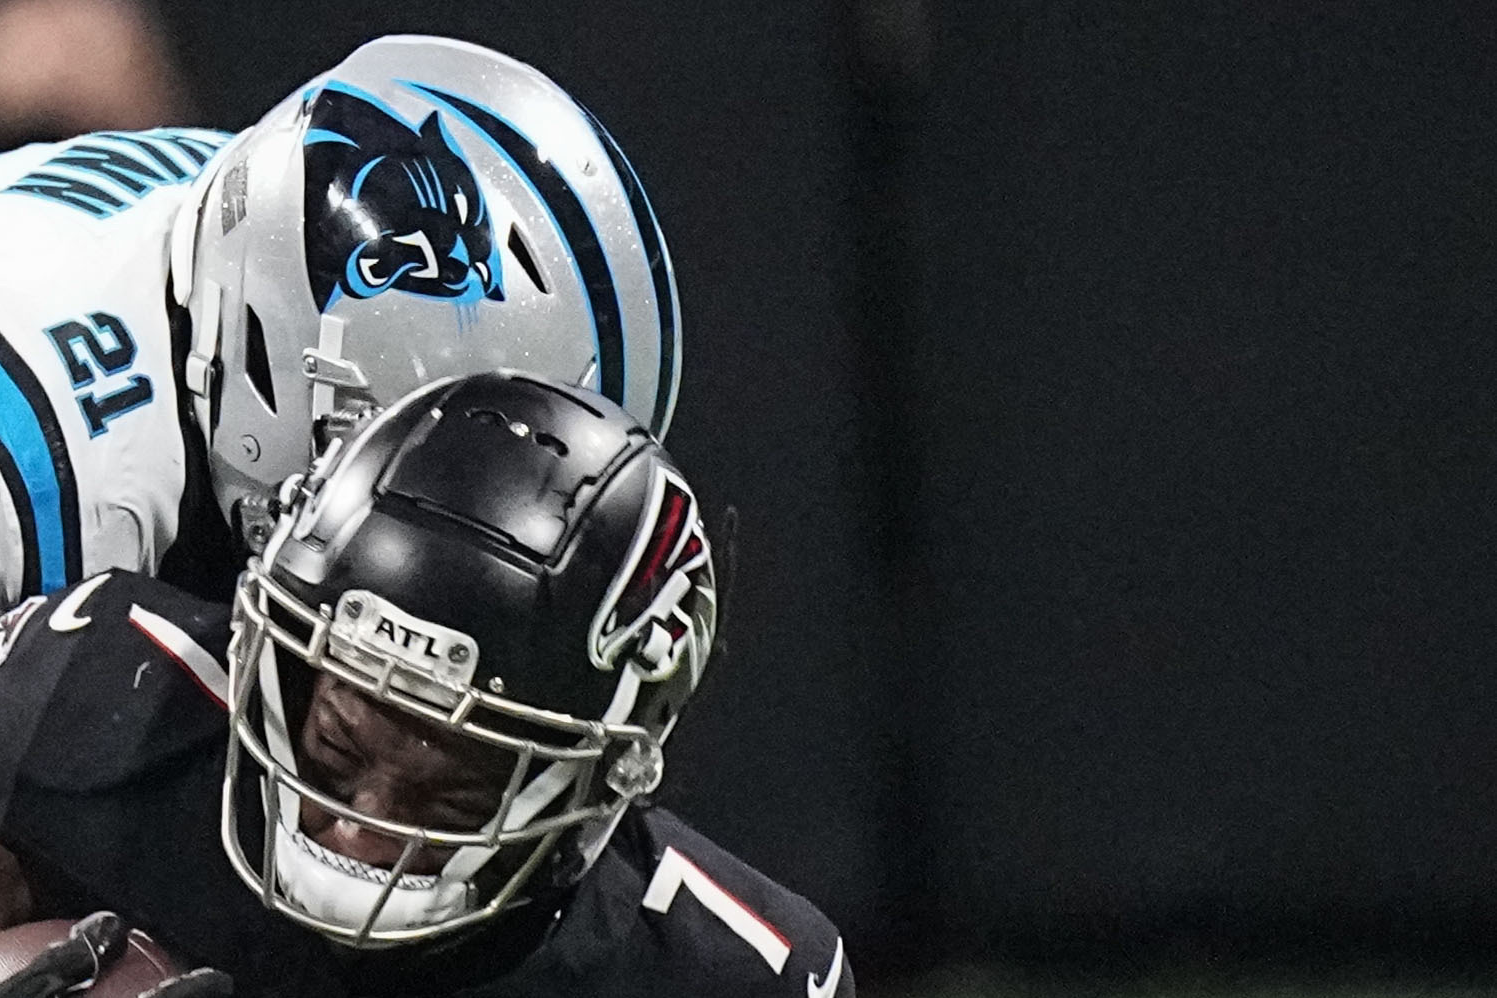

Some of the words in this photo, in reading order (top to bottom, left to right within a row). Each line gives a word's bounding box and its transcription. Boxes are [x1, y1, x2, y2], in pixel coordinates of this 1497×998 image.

[42, 309, 154, 440] 21
[374, 614, 441, 659] ATL
[642, 845, 793, 976] 7
